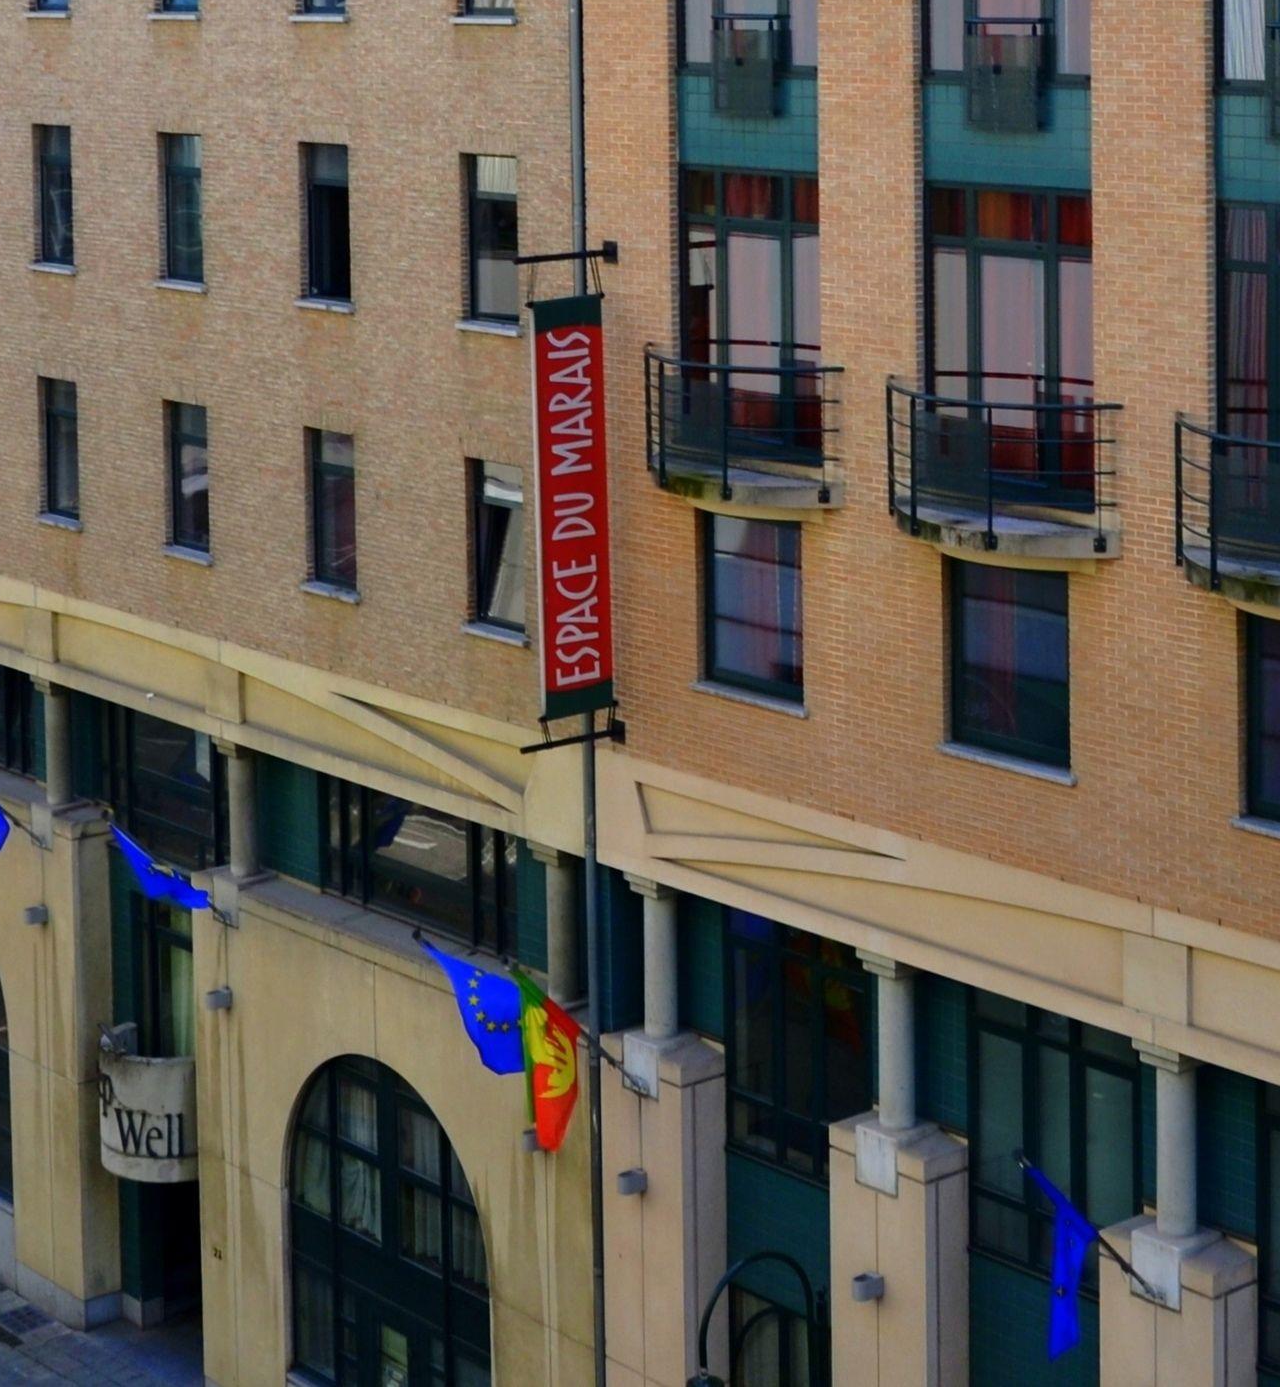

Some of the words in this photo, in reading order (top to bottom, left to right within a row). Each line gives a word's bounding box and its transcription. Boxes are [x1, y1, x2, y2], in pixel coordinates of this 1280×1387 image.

[547, 330, 593, 477] MARAIS
[551, 491, 596, 543] DU
[552, 553, 601, 688] ESPACE
[114, 1107, 185, 1160] Well
